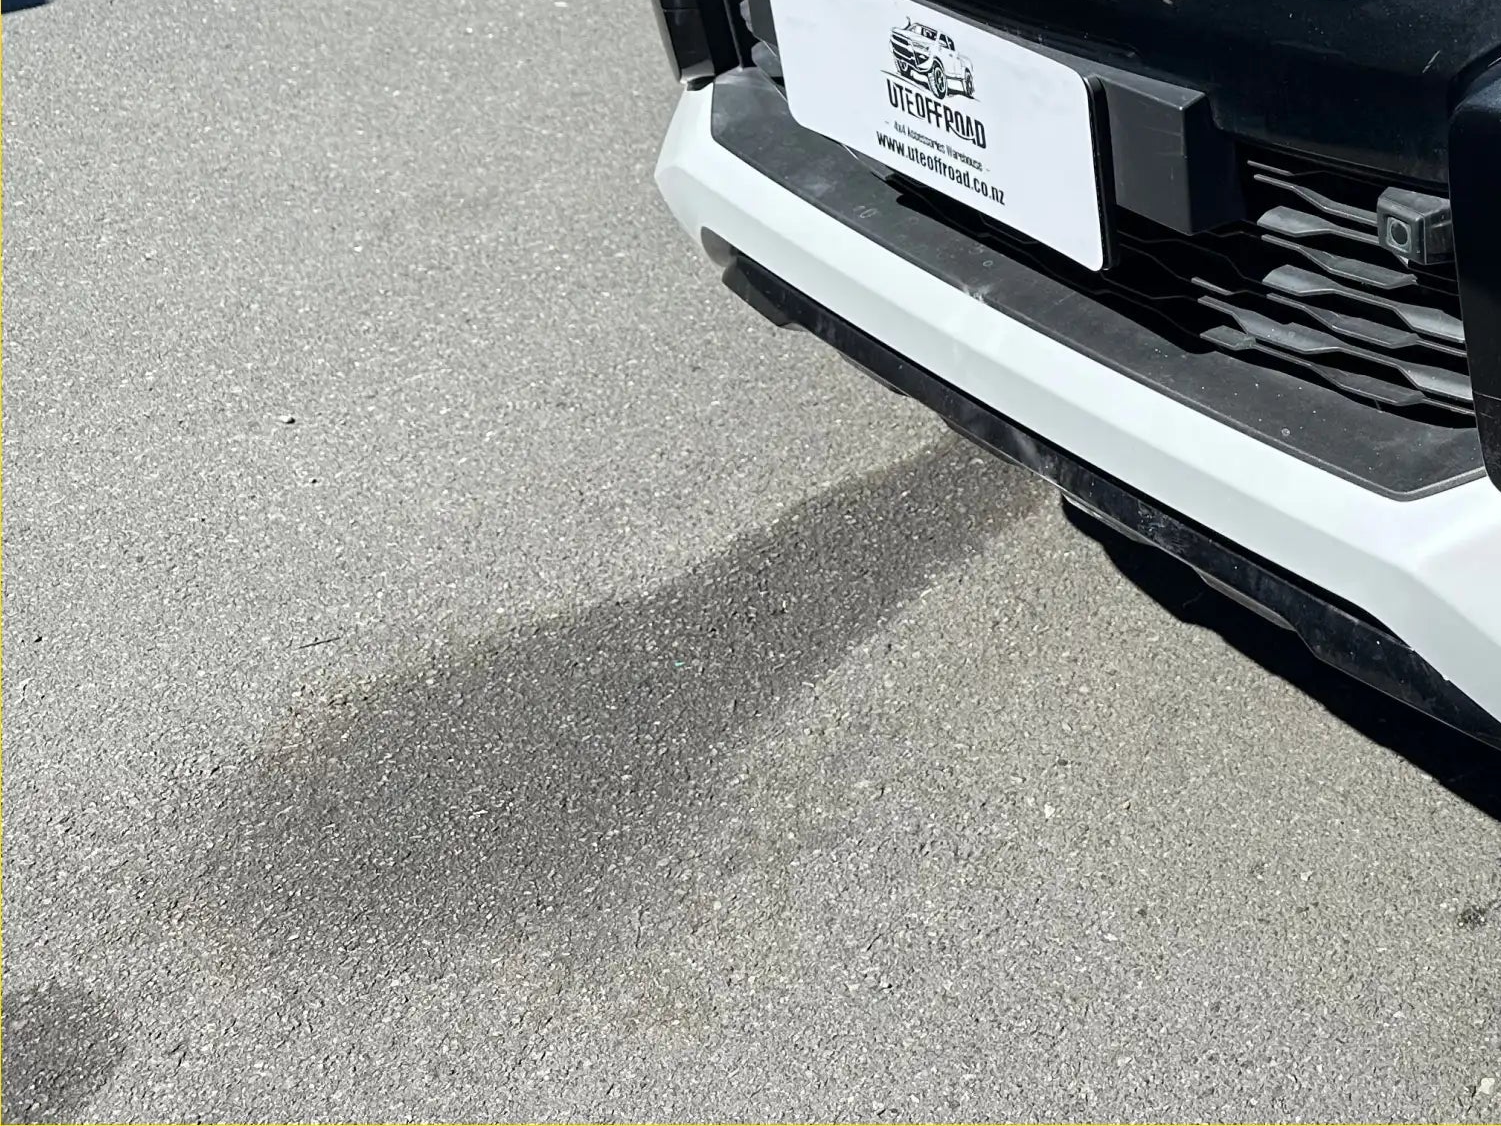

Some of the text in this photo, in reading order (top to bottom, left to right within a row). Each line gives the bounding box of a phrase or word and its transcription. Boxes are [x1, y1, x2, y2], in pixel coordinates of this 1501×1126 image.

[886, 77, 987, 150] UTEOFFROAD
[907, 125, 946, 155] Accessories
[945, 144, 984, 172] Warehouse
[875, 130, 1006, 206] www.uteoffroad.co.nz
